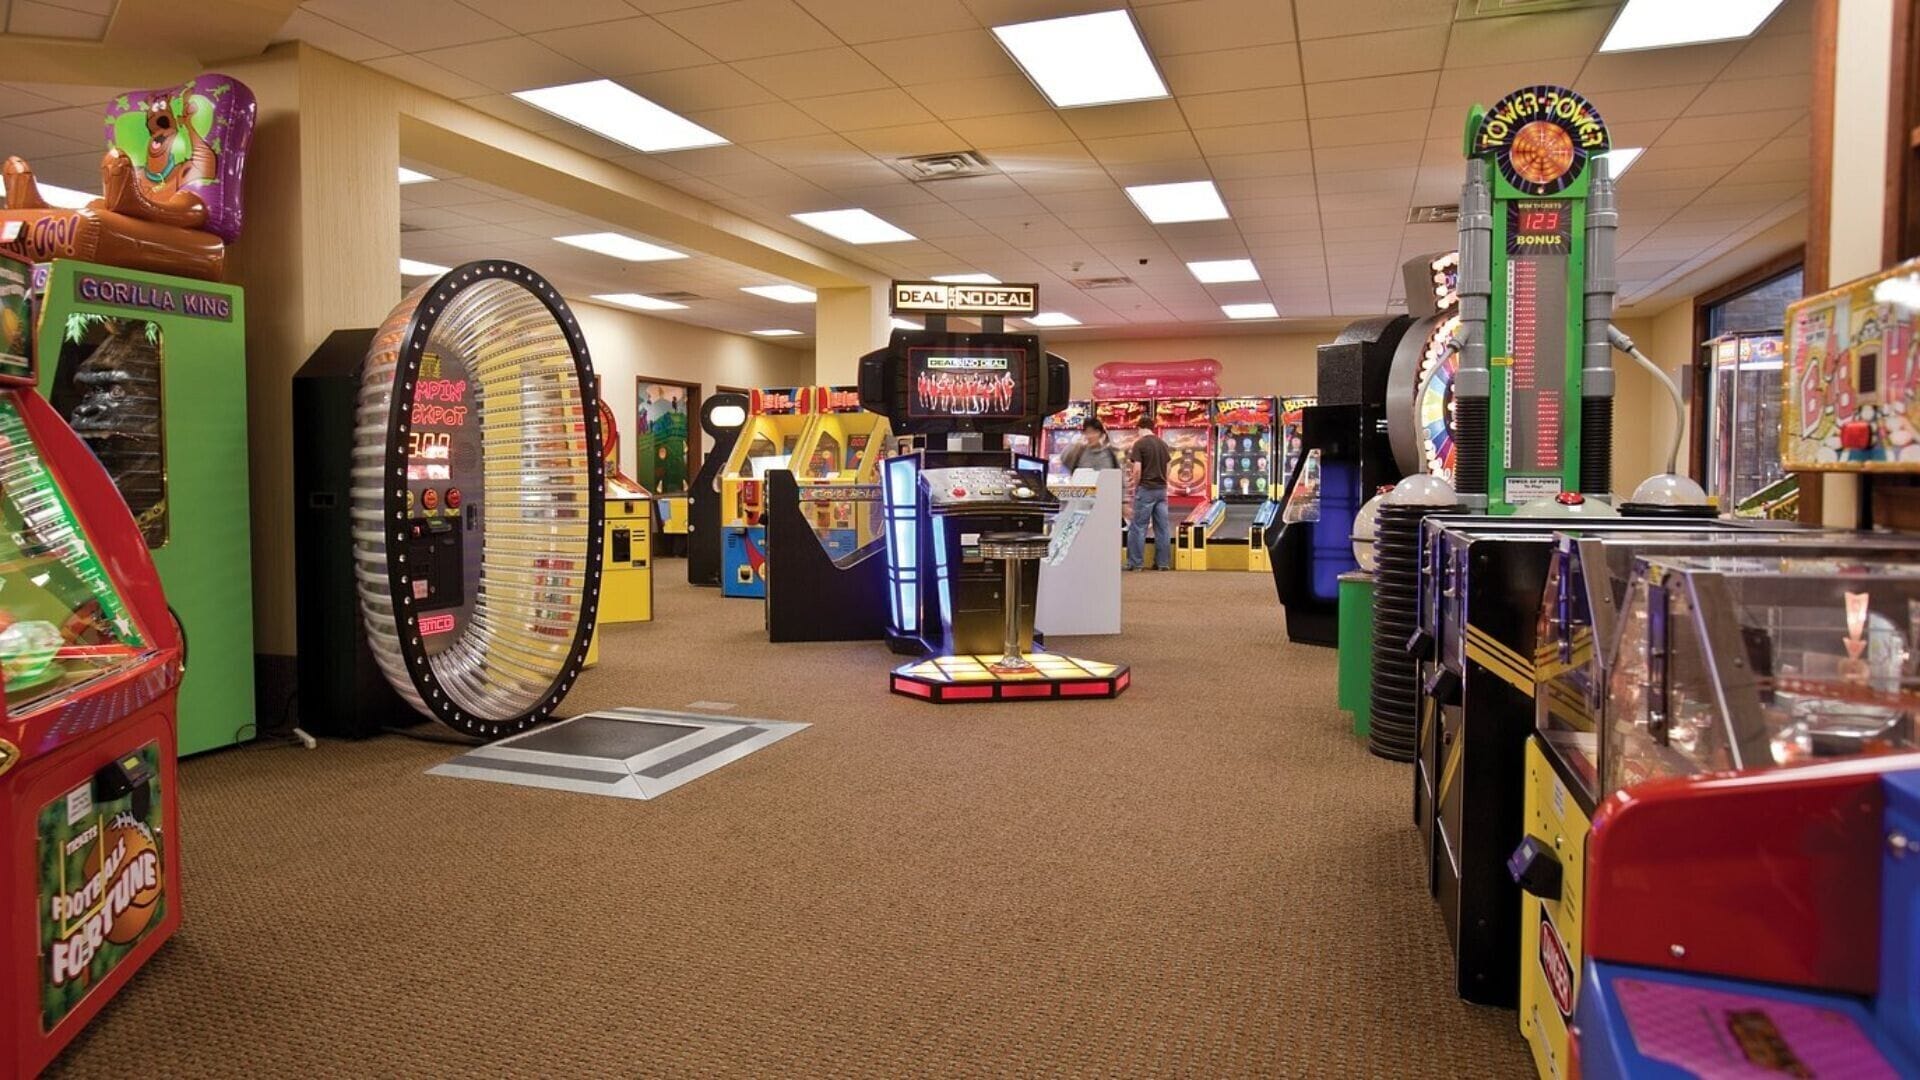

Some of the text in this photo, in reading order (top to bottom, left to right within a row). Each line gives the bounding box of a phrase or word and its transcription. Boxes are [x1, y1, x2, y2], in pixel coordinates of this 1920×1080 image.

[1525, 213, 1559, 230] 123
[1516, 234, 1562, 246] BONUS
[82, 277, 175, 310] GORILLA
[182, 294, 229, 318] KING
[899, 290, 944, 303] DEAL
[958, 292, 983, 304] NO
[985, 292, 1030, 306] DEAL
[419, 617, 452, 634] amco
[52, 851, 157, 984] FORTUNE
